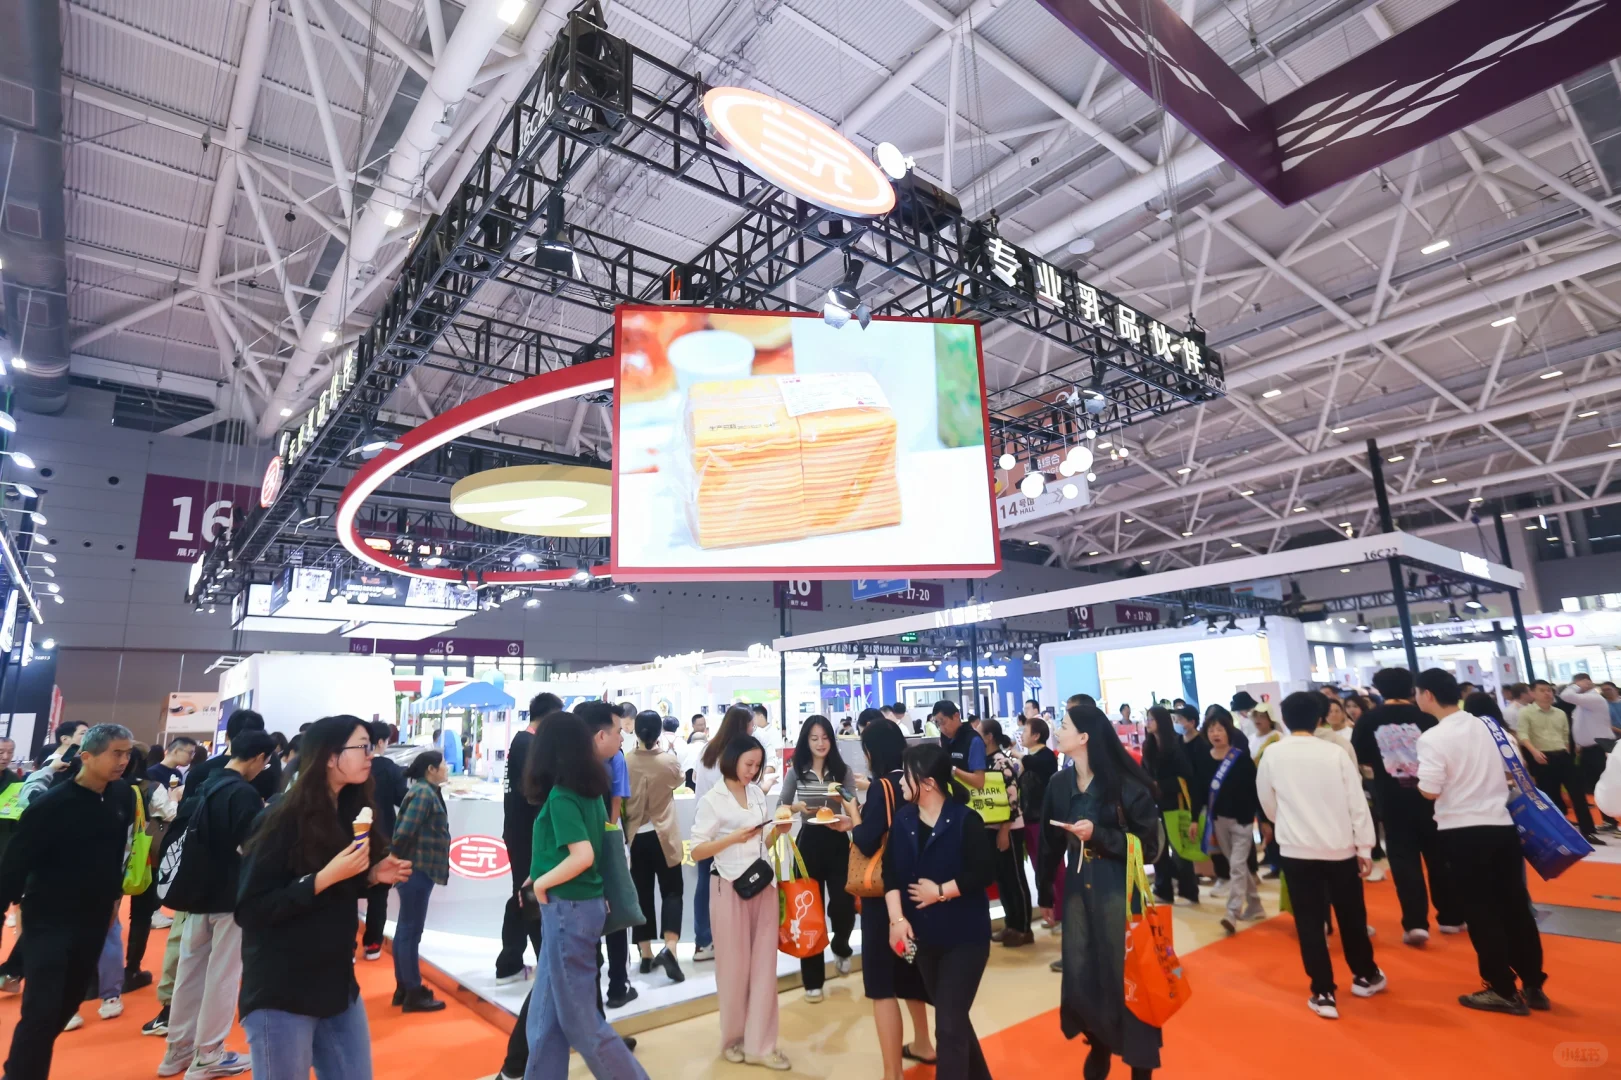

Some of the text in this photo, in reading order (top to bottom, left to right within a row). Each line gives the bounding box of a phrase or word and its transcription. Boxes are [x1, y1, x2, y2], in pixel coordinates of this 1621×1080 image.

[517, 91, 553, 157] 16C20
[988, 236, 1206, 376] 专业乳品伙伴
[1000, 500, 1018, 520] 14
[1019, 506, 1035, 515] HALL
[169, 496, 234, 545] 16
[176, 547, 198, 558] 展厅
[1363, 546, 1398, 561] 16C22
[907, 587, 930, 601] 17-20
[445, 640, 454, 654] 6
[979, 787, 1002, 796] MARK
[459, 845, 498, 869] 三元
